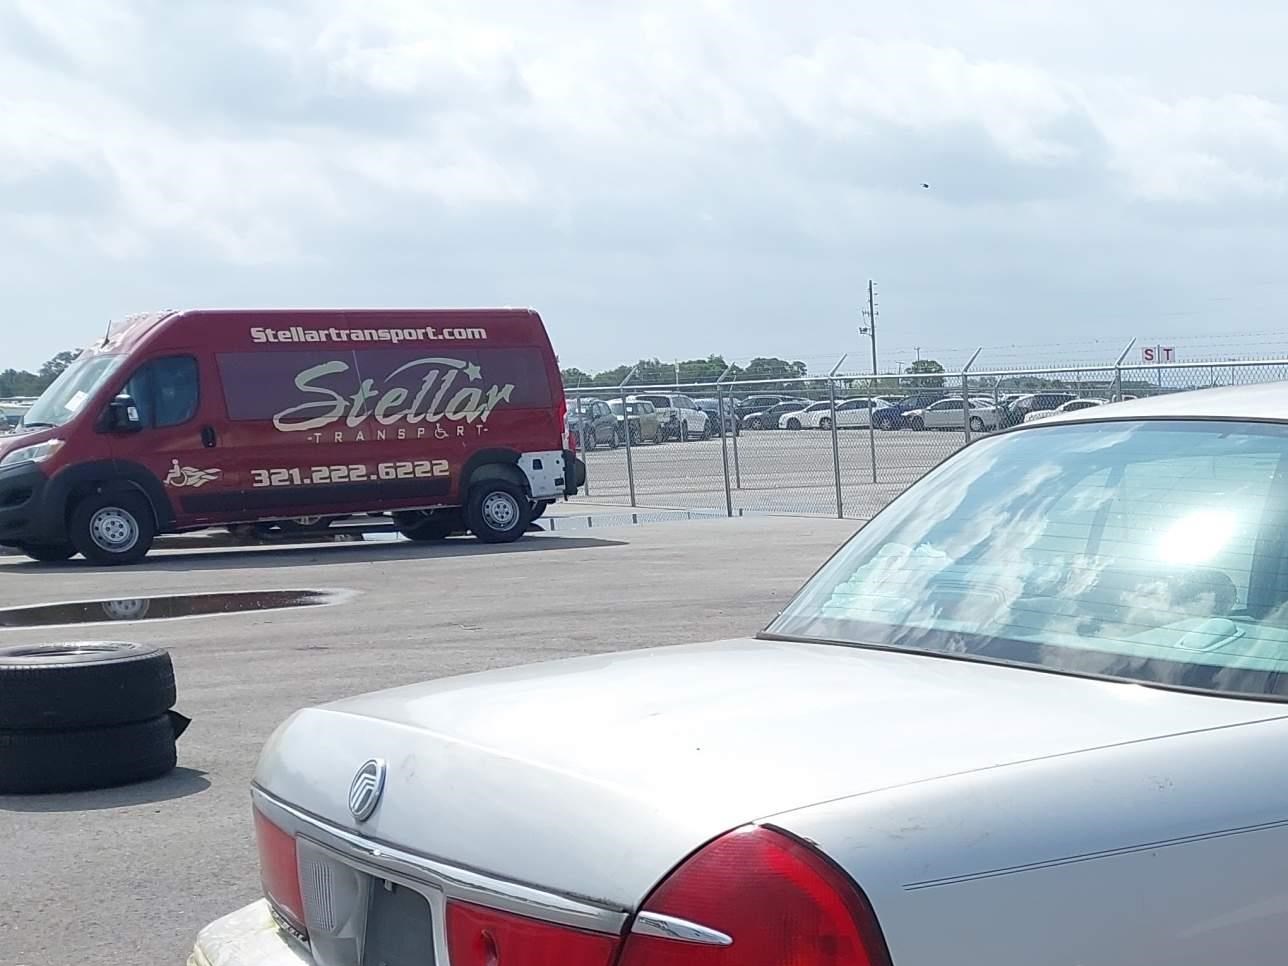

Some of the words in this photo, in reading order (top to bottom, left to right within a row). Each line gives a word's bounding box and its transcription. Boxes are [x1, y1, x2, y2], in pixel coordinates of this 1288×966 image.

[250, 326, 488, 344] Stellartransport.com
[1143, 347, 1155, 361] S
[1162, 347, 1173, 361] T
[272, 361, 515, 432] Stellar
[250, 459, 450, 487] 321.222.6222
